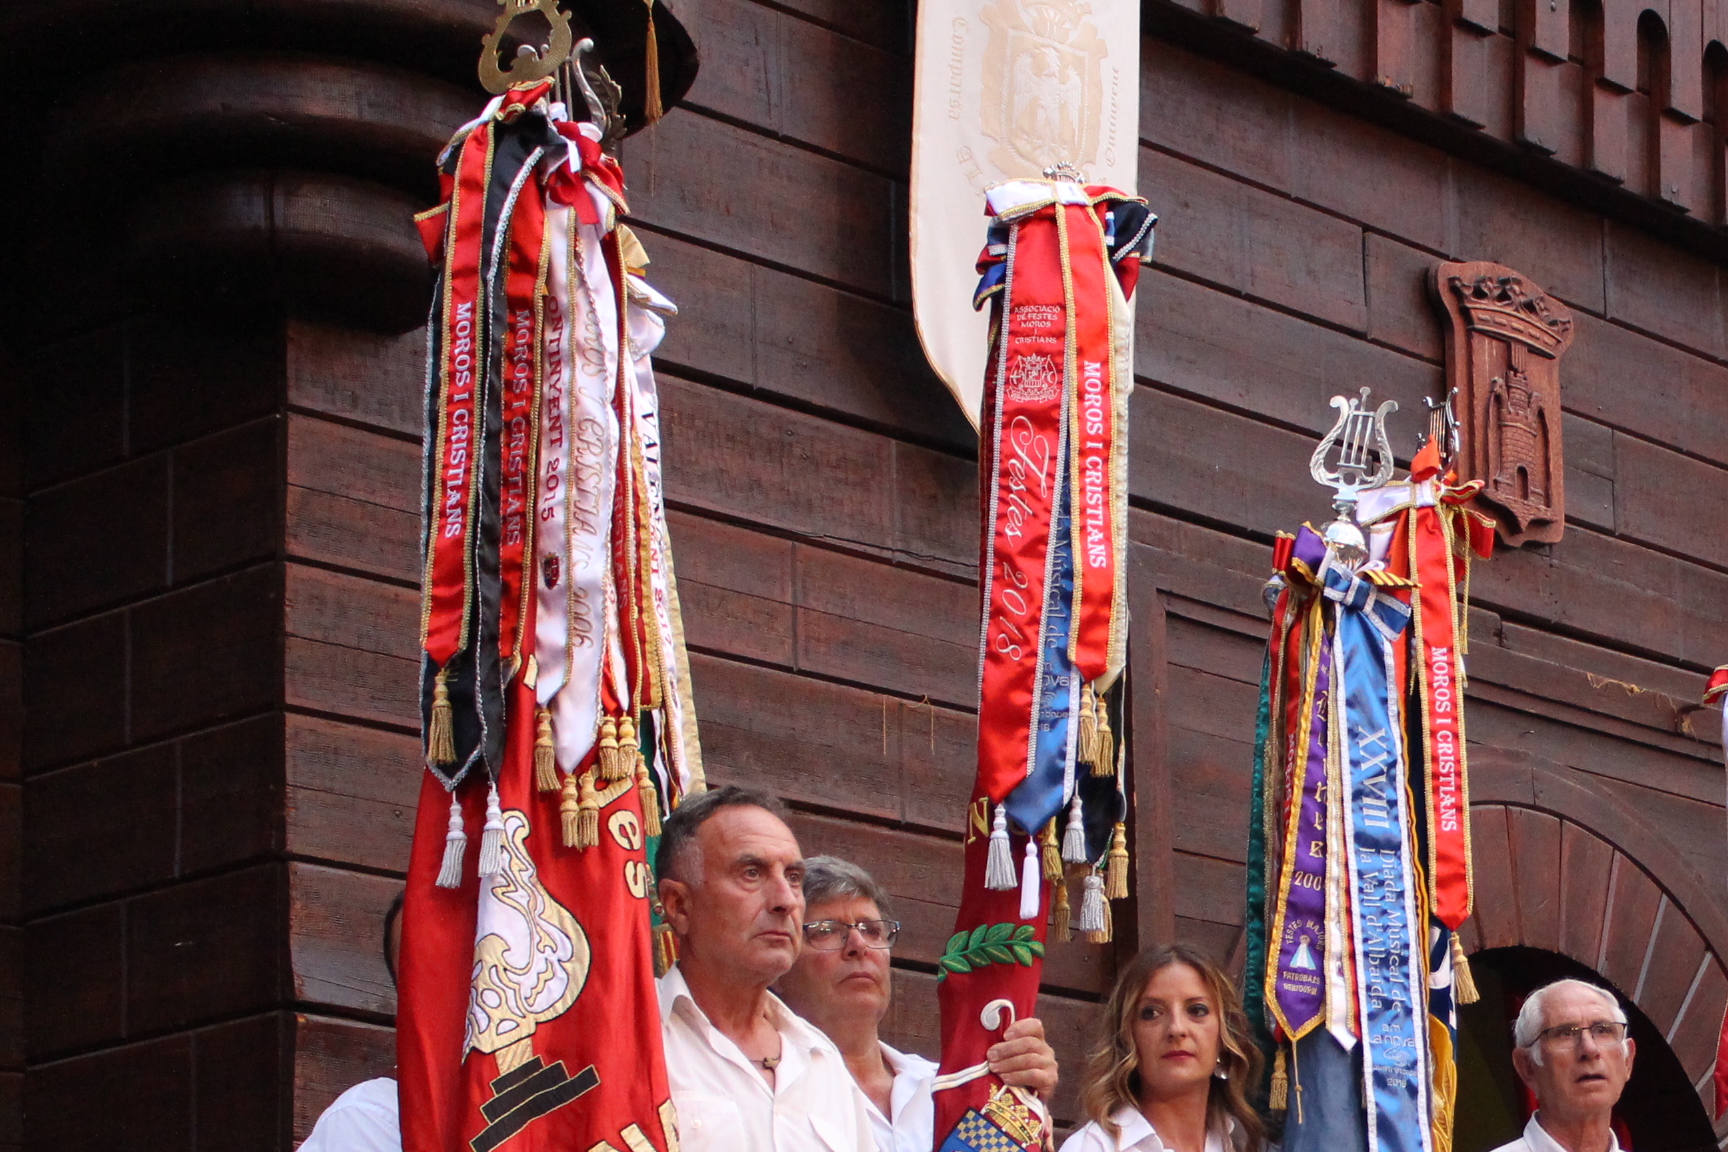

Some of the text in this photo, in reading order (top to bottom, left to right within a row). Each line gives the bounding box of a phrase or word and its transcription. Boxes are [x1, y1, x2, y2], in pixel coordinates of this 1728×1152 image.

[1014, 336, 1058, 345] CRISTIANS
[1016, 313, 1058, 321] DE FESTES
[1020, 321, 1051, 329] MOROS
[445, 301, 472, 539] MOROS I CRISTIANS
[506, 310, 533, 547] MOROS I CRISTIANS
[1083, 361, 1103, 435] MOROS
[540, 456, 560, 522] 2015
[1084, 456, 1107, 569] CRISTIANS
[996, 415, 1049, 661] Festes 2018
[1431, 647, 1457, 832] MOROS I CRISTIANS
[1358, 726, 1390, 829] XXVIII
[1359, 847, 1376, 864] la
[1379, 849, 1402, 902] Diada
[1362, 873, 1382, 908] Vall
[1389, 988, 1402, 1012] de
